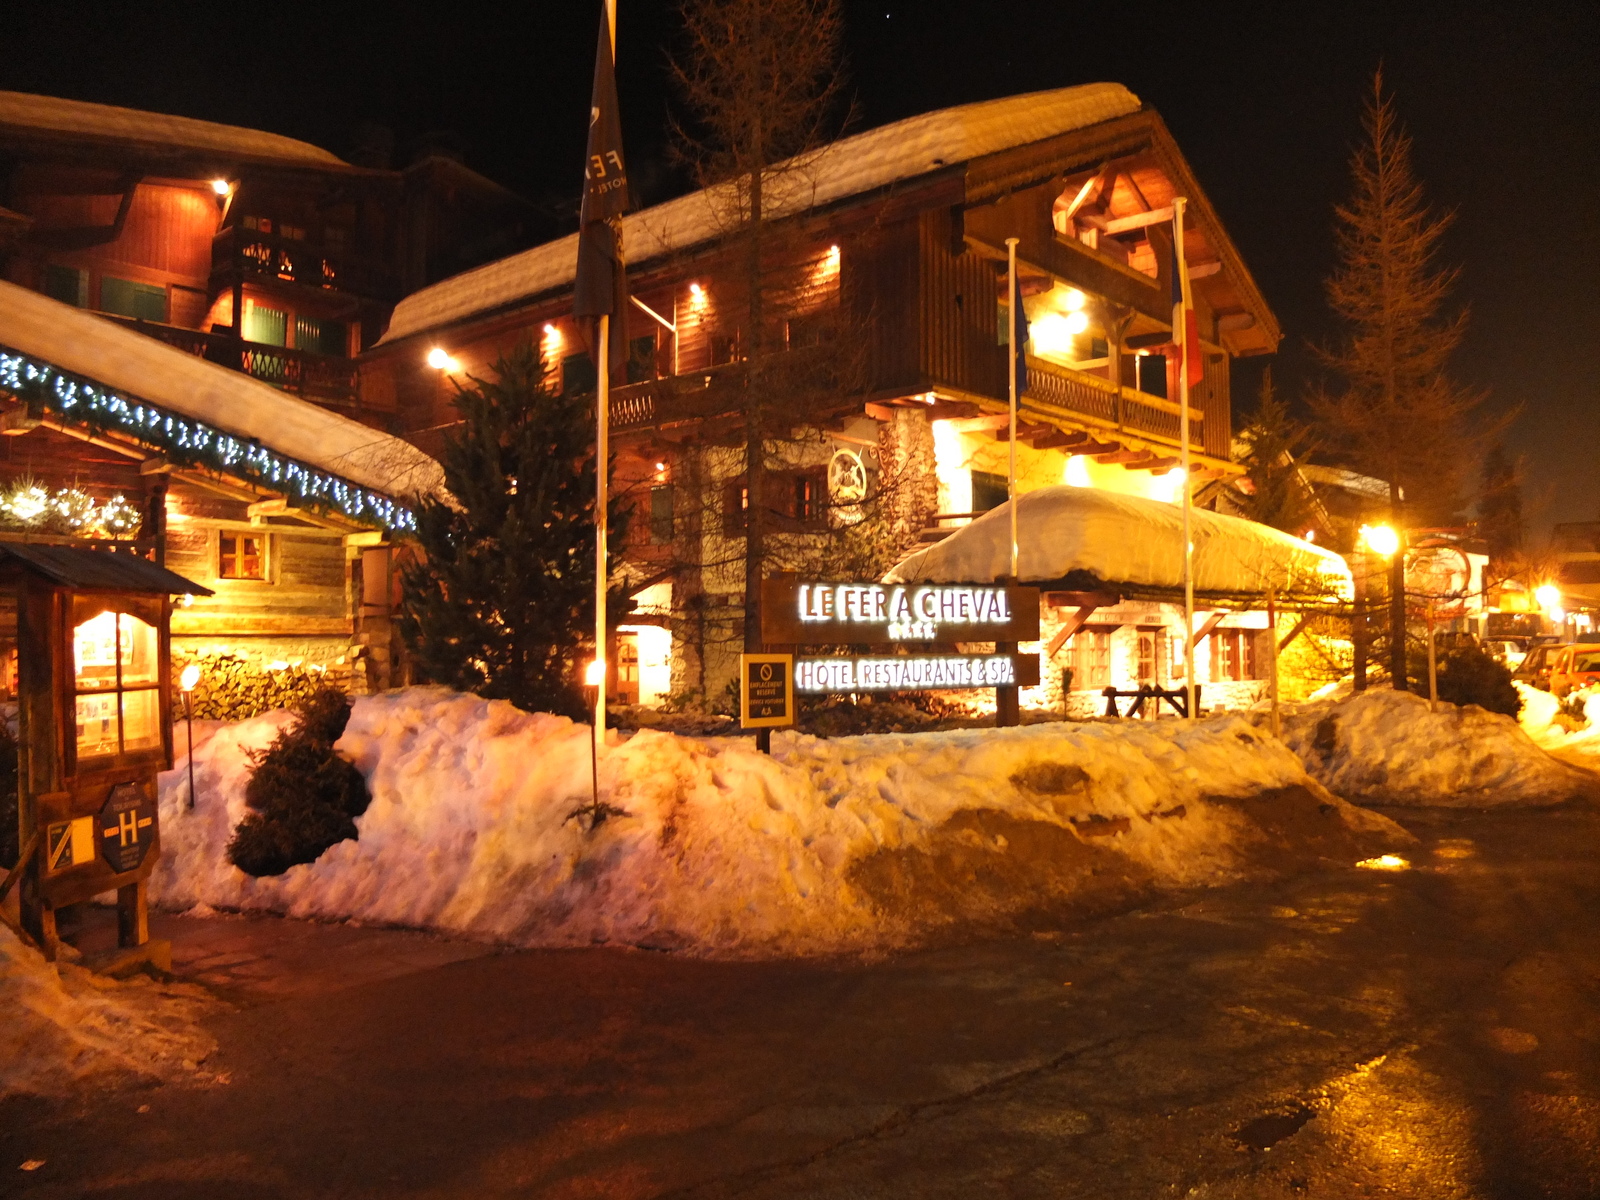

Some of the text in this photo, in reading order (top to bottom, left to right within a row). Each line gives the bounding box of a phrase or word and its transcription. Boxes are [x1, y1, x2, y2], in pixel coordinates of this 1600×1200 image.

[801, 586, 1011, 619] LE FER A CHEVAL
[798, 659, 1014, 687] HOTEL RESTAURANTS & SPA
[119, 809, 138, 847] H
